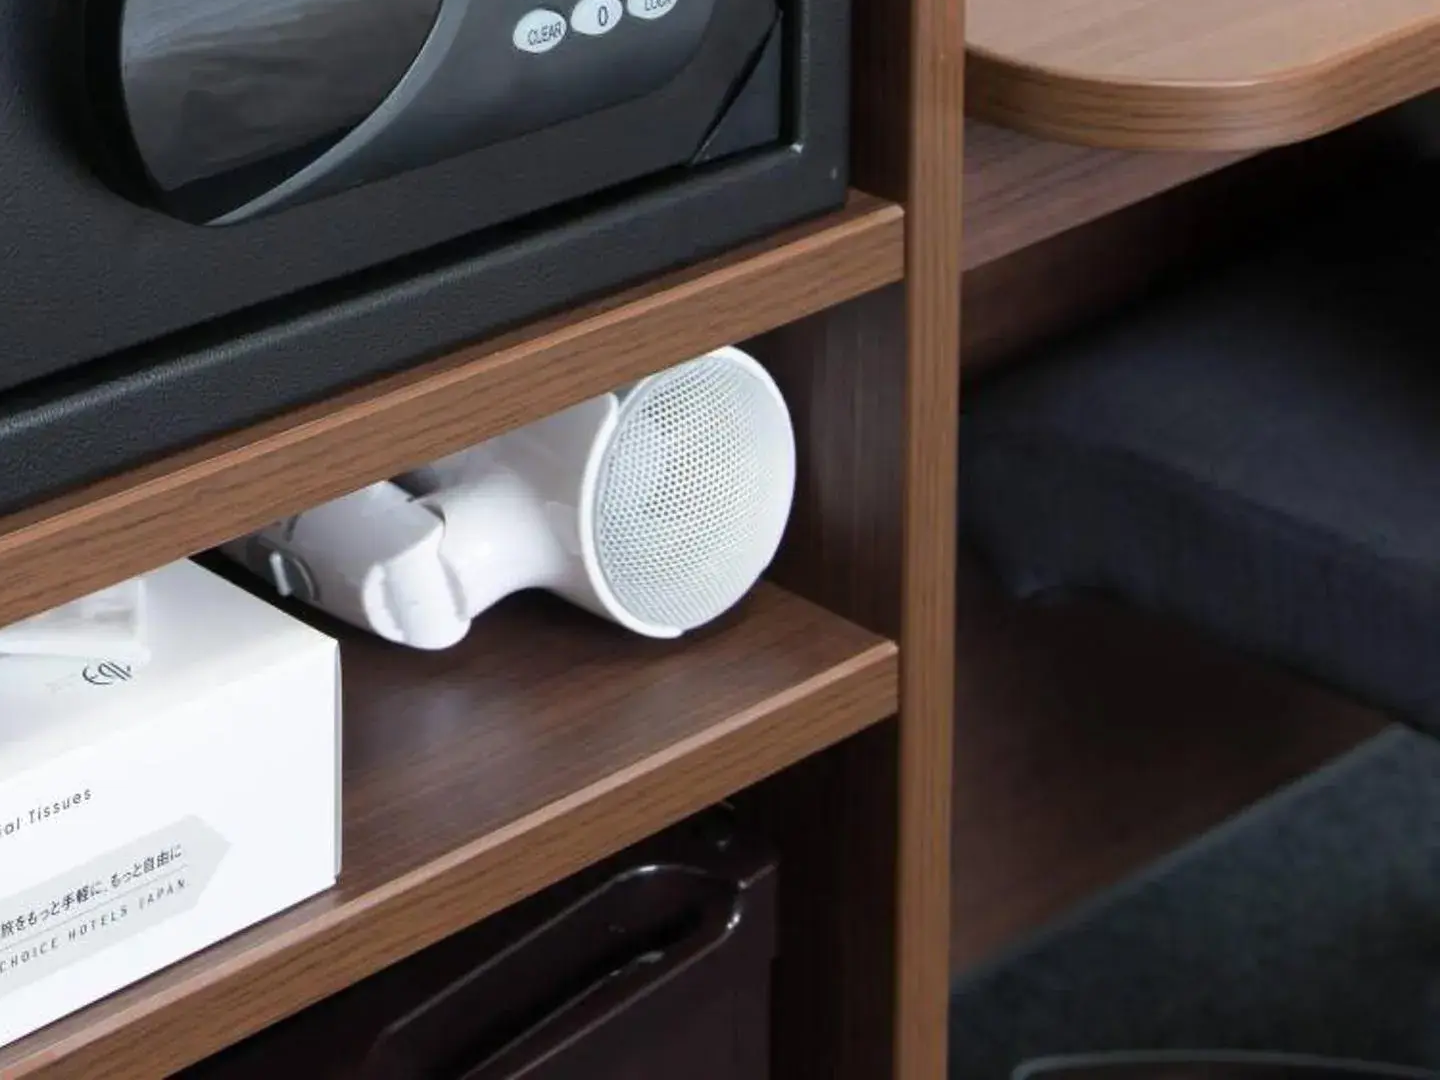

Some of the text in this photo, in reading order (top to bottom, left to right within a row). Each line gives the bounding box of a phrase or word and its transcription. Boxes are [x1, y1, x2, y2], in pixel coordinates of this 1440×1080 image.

[527, 21, 562, 46] CLEAR
[597, 5, 609, 27] 0
[28, 788, 92, 824] Tissues
[68, 904, 128, 941] HOTELS
